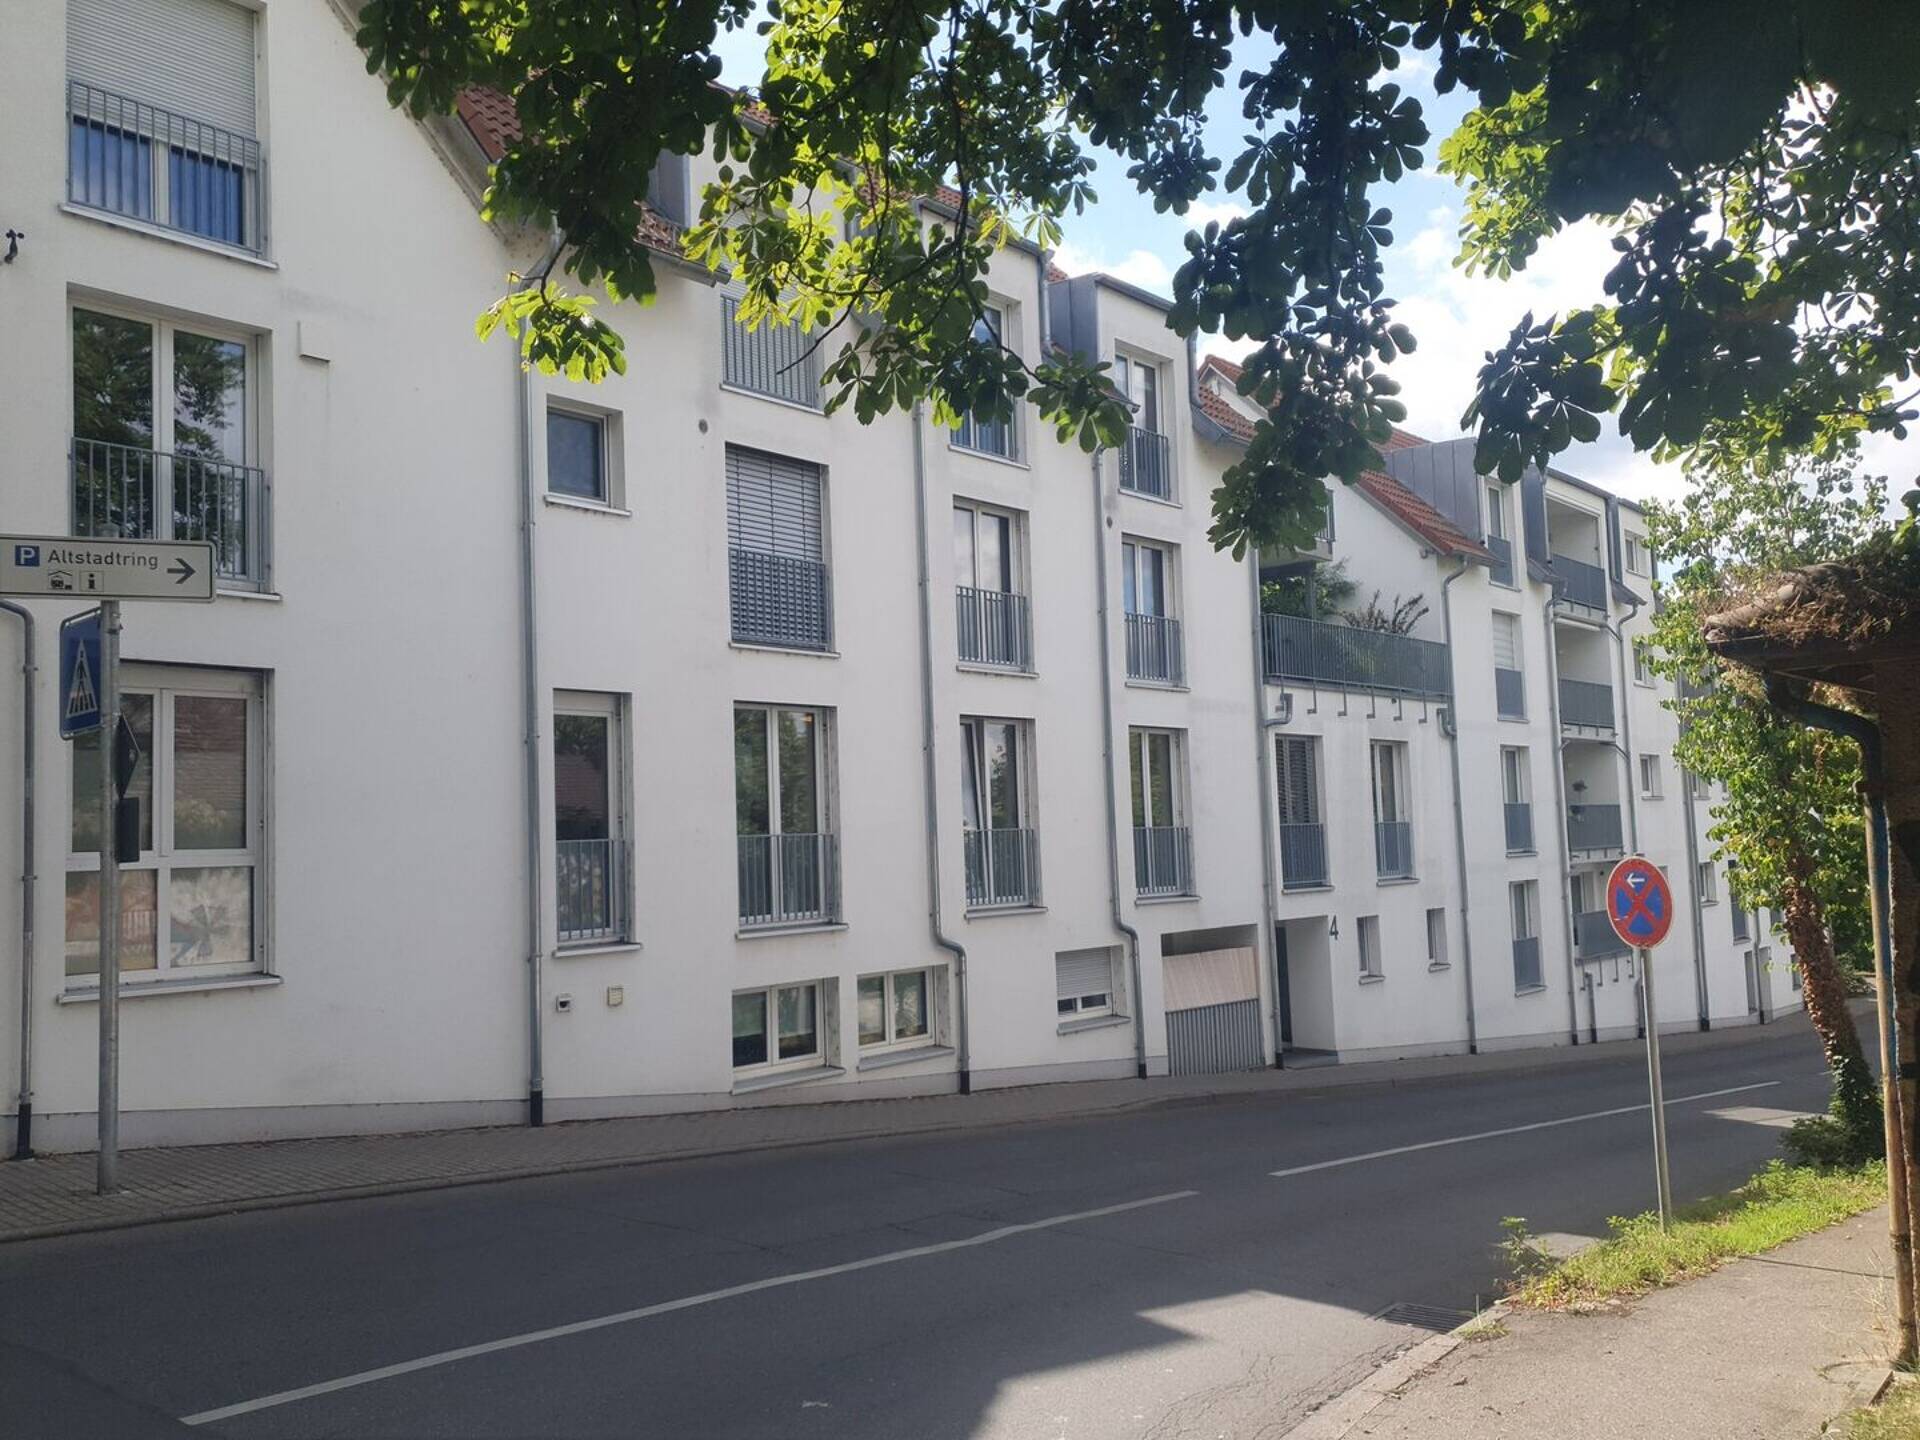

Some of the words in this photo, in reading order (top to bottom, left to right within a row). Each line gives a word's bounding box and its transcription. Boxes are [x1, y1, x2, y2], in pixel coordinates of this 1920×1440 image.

[20, 547, 35, 565] P
[47, 549, 159, 570] Altstadtring
[1329, 914, 1339, 940] 4
